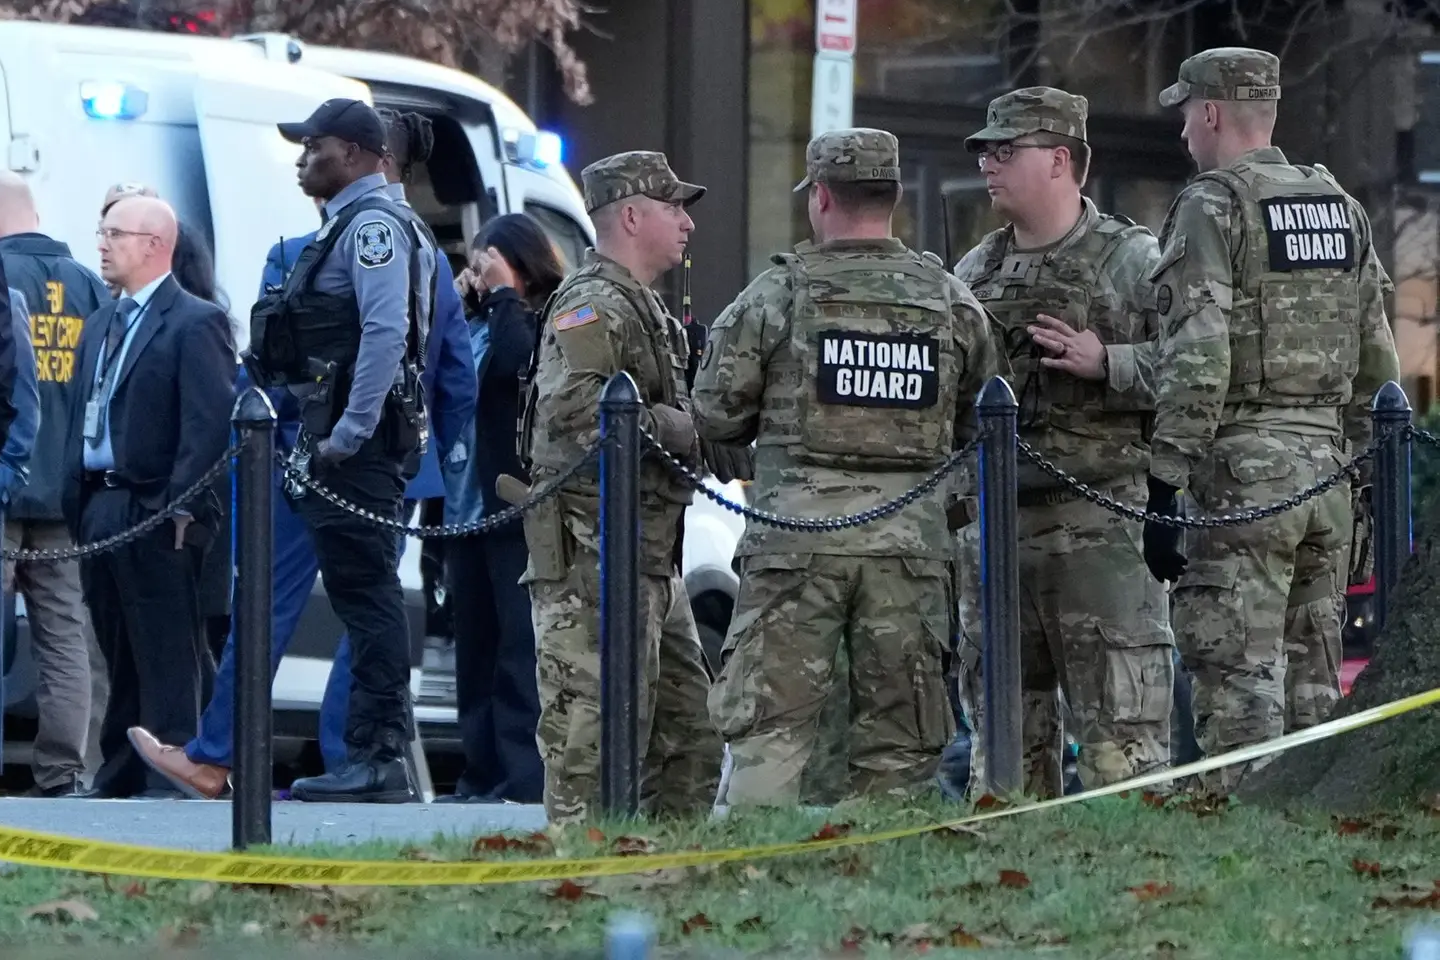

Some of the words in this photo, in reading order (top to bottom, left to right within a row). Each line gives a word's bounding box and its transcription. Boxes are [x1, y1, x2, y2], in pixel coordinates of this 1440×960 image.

[1267, 203, 1350, 231] NATIONAL
[1285, 233, 1347, 261] GUARD
[824, 339, 935, 371] NATIONAL
[836, 368, 922, 400] GUARD
